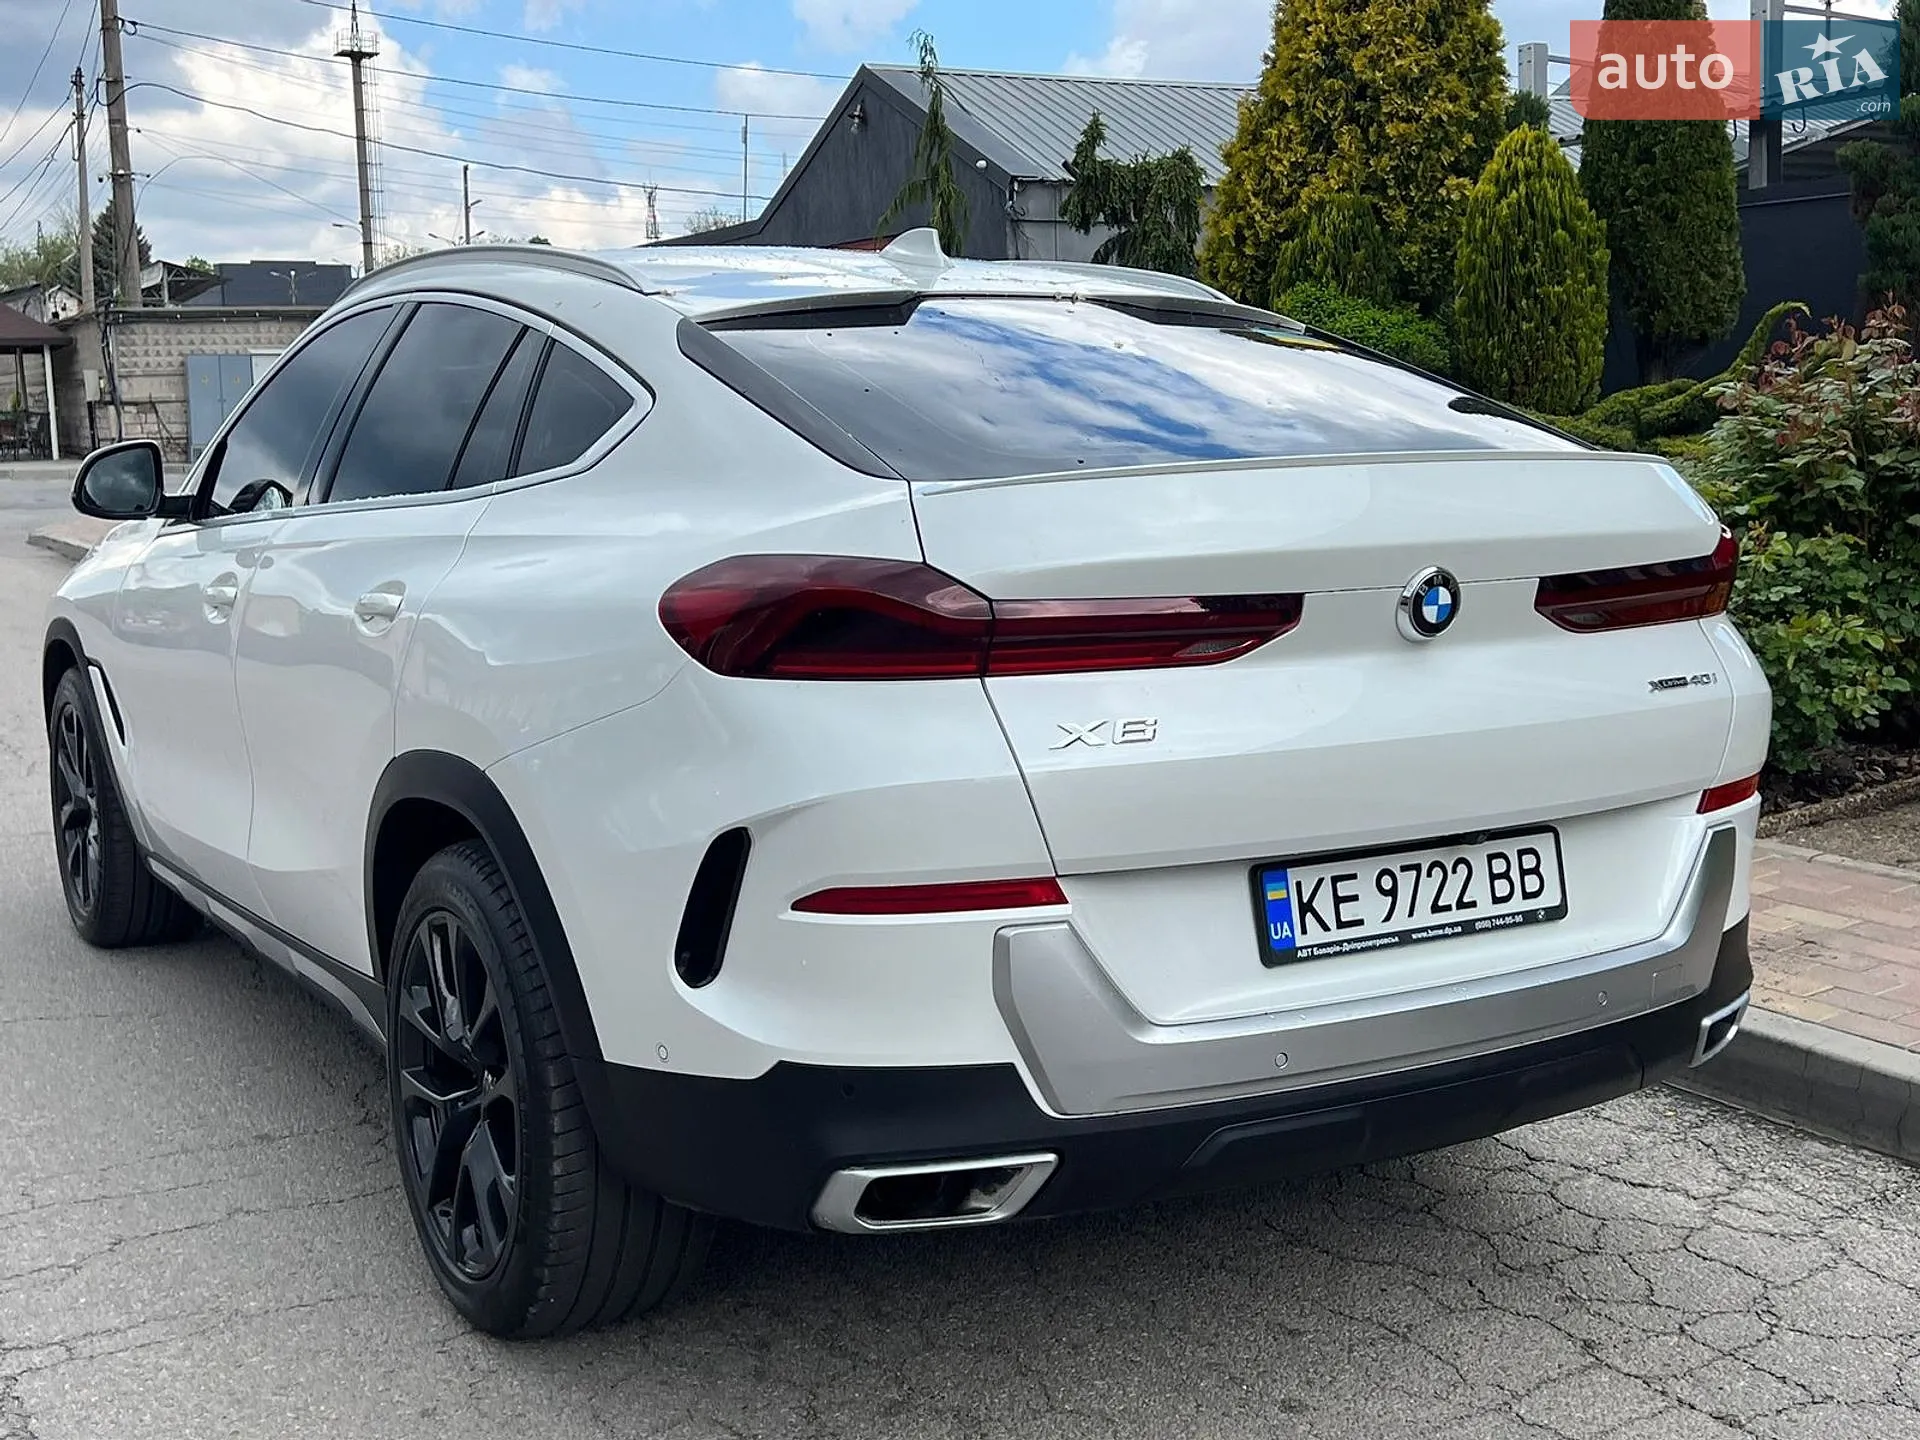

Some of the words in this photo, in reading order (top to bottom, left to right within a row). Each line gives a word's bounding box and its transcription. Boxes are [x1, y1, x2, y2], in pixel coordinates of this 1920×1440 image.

[1418, 574, 1458, 595] BMW
[1048, 719, 1158, 750] X6
[1295, 872, 1365, 935] KE
[1375, 856, 1478, 923] 9722
[1486, 847, 1546, 905] BB
[1270, 921, 1292, 939] UA
